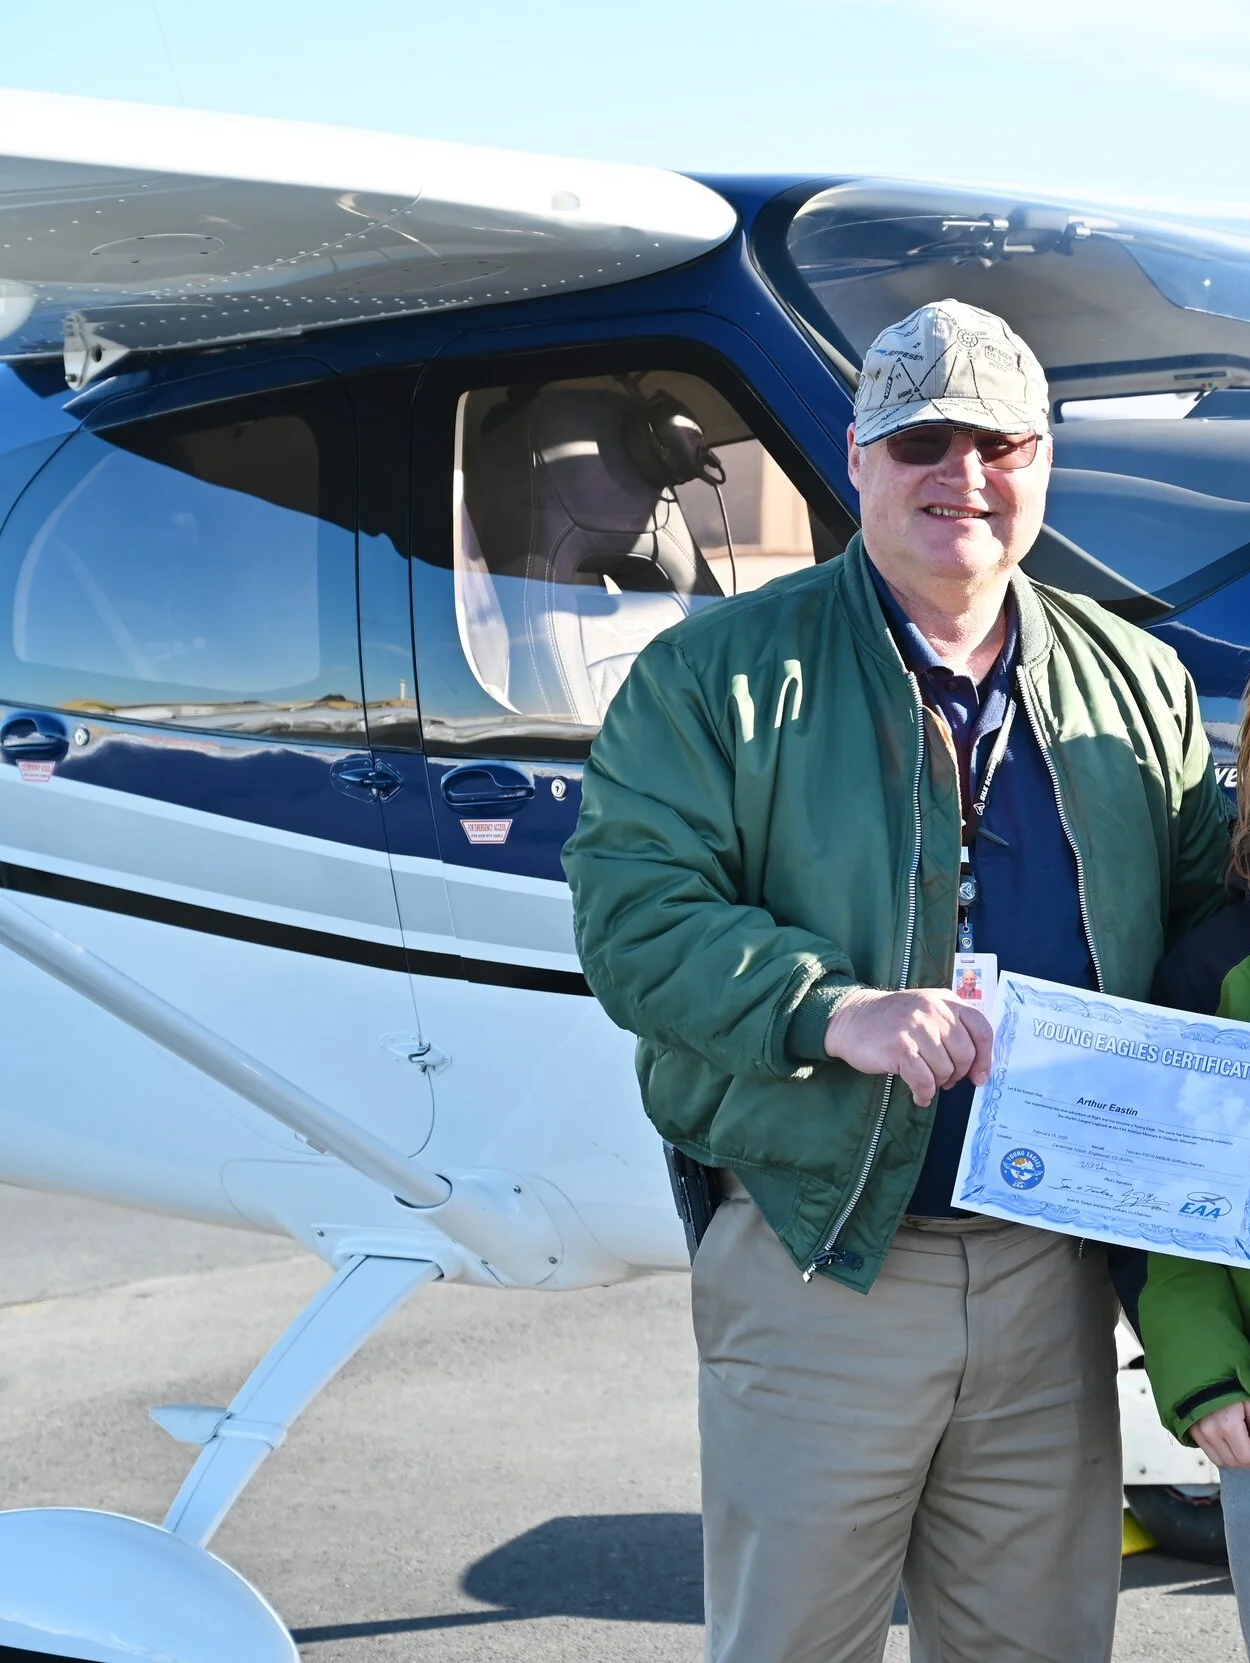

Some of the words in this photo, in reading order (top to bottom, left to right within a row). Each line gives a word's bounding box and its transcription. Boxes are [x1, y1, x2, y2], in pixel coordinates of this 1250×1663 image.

[885, 350, 925, 361] JEPPESEN
[980, 785, 988, 801] SILK
[1033, 1018, 1093, 1048] YOUNG
[1095, 1034, 1159, 1062] EAGLES
[1076, 1096, 1108, 1109] Arthur
[1109, 1103, 1138, 1116] Eastin
[1179, 1202, 1221, 1219] EAA
